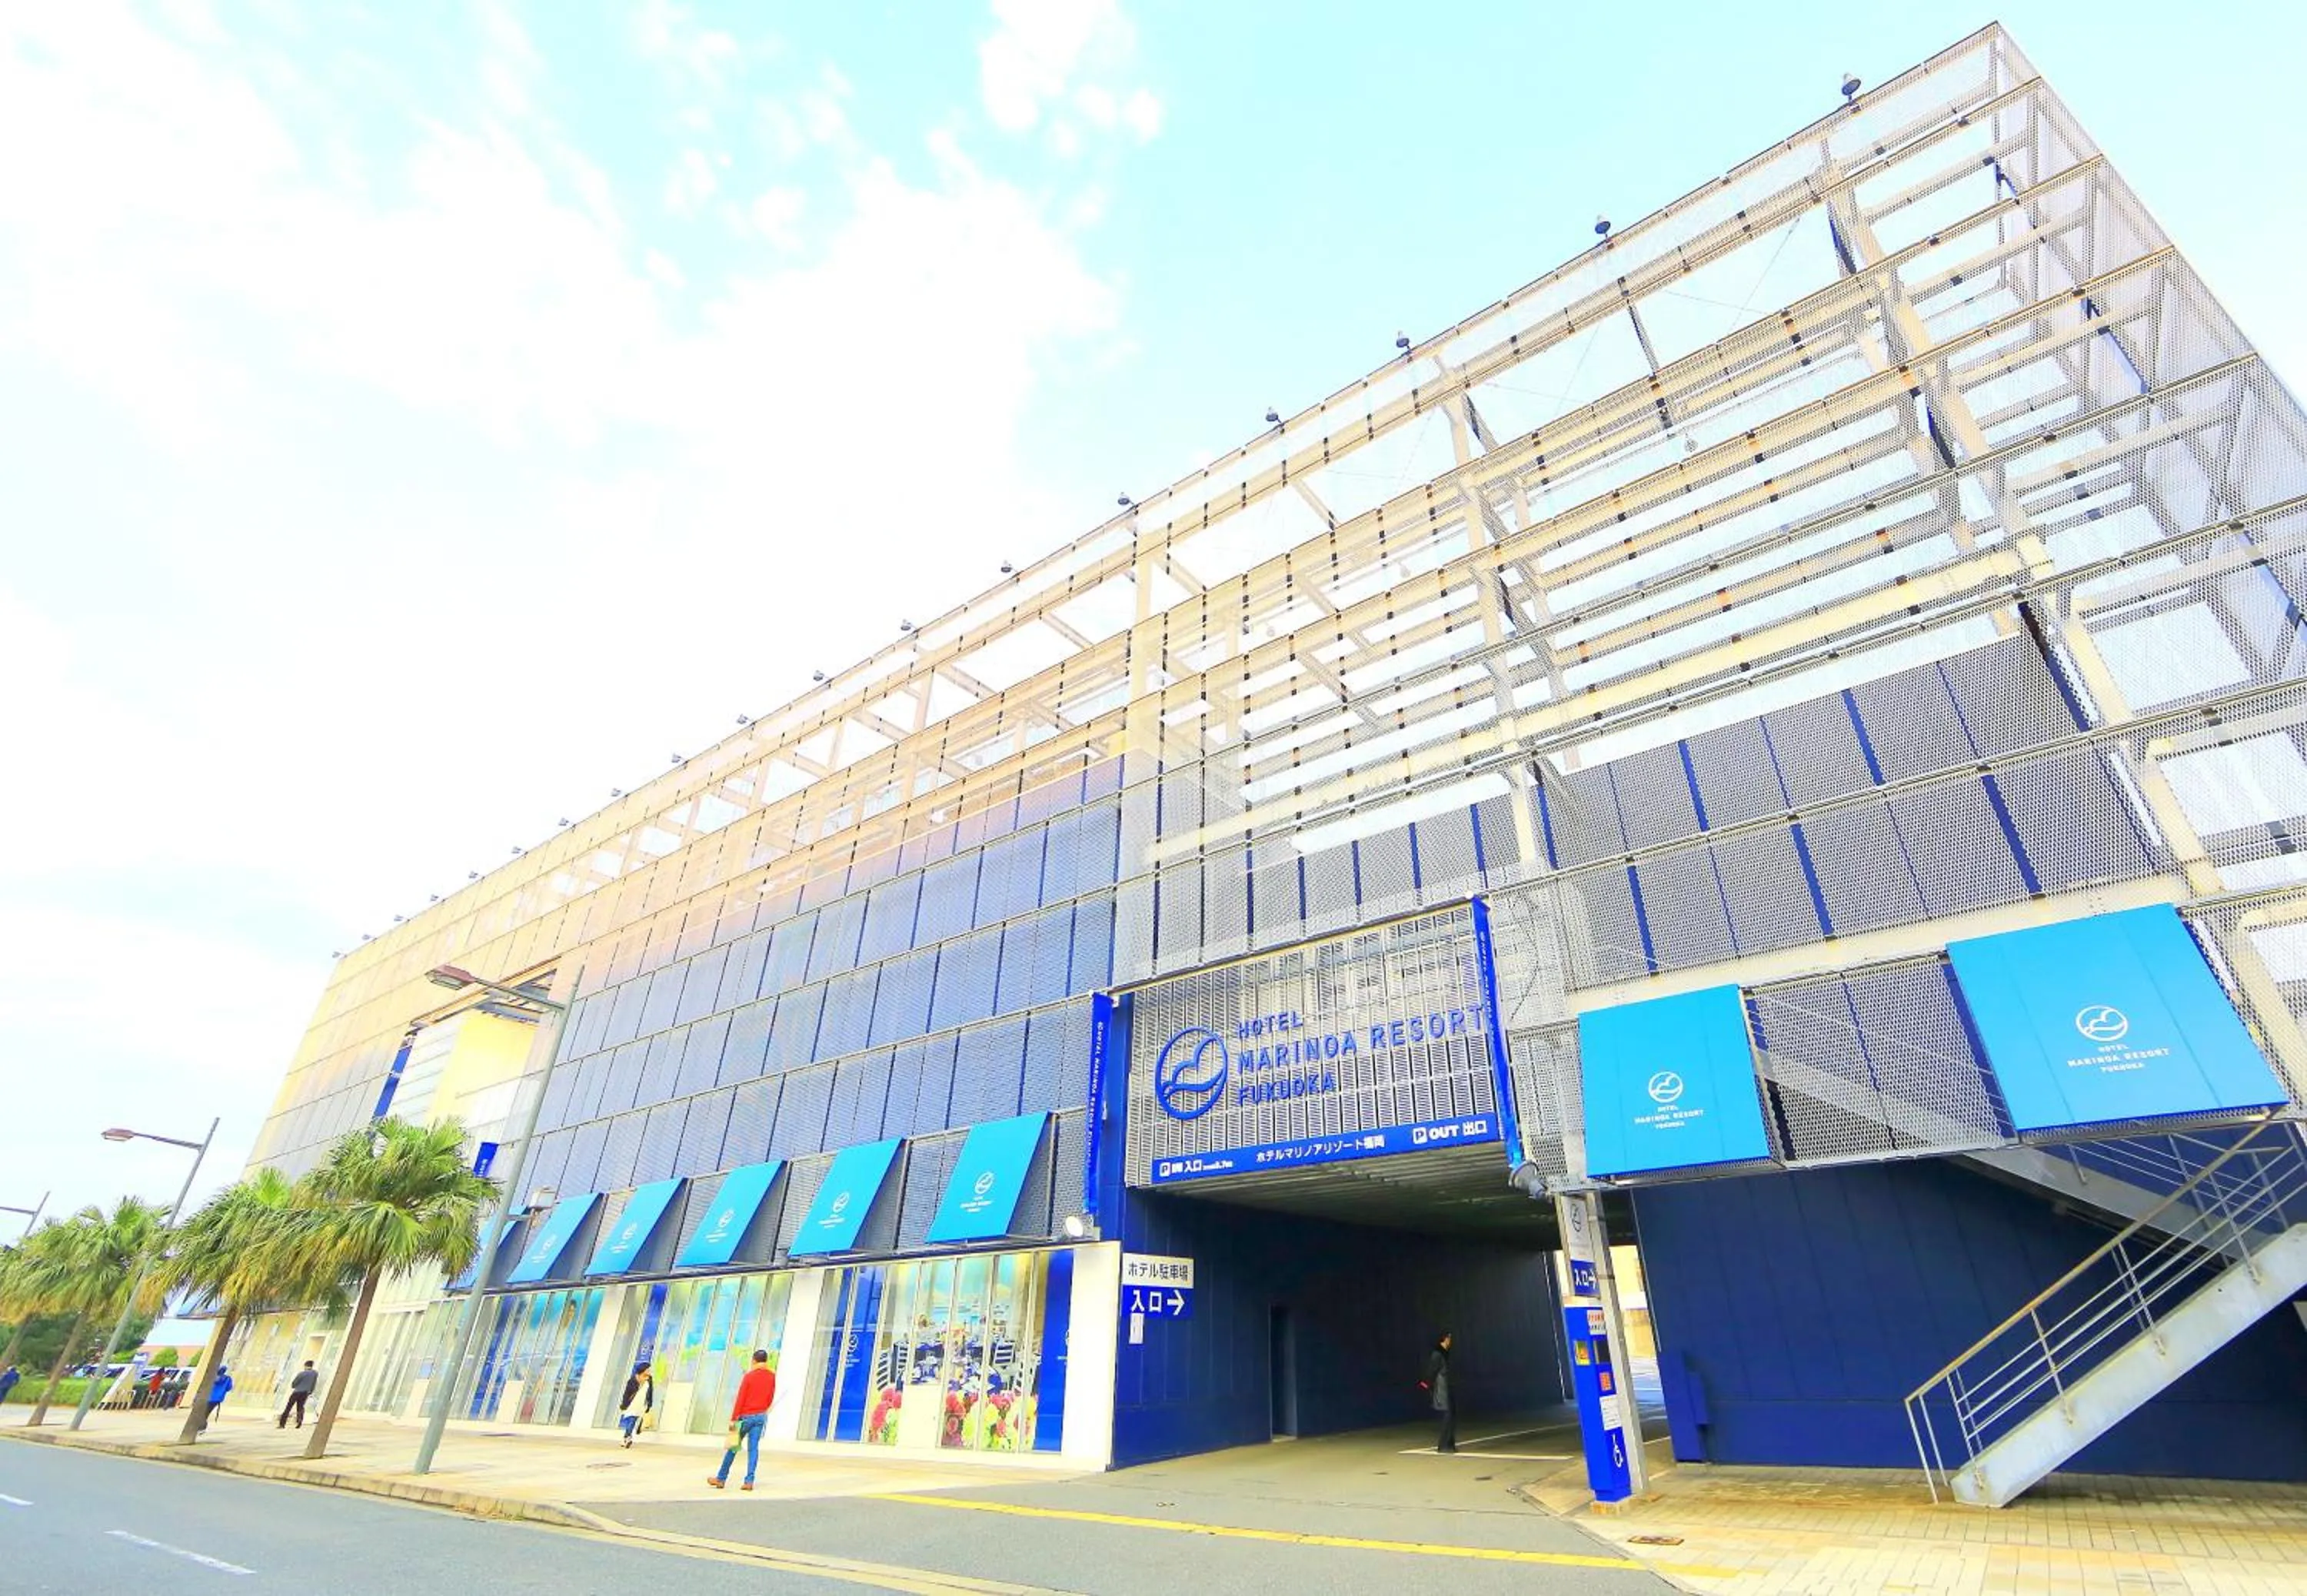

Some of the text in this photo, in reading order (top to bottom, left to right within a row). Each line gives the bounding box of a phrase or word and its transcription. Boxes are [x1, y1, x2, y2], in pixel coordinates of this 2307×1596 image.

[1238, 1011, 1303, 1039] HOTEL
[1237, 1030, 1357, 1076] MARINOA
[1370, 1003, 1484, 1049] RESORT
[2067, 1047, 2169, 1068] MARINOA RESORT
[1237, 1072, 1336, 1106] FUKUOKA
[1429, 1124, 1460, 1140] OUT
[1462, 1120, 1488, 1136] 出口
[1184, 1159, 1203, 1173] 入口
[1128, 1261, 1189, 1282] ホテル駐車場
[1574, 1268, 1589, 1287] 入口
[1130, 1288, 1163, 1313] 入口
